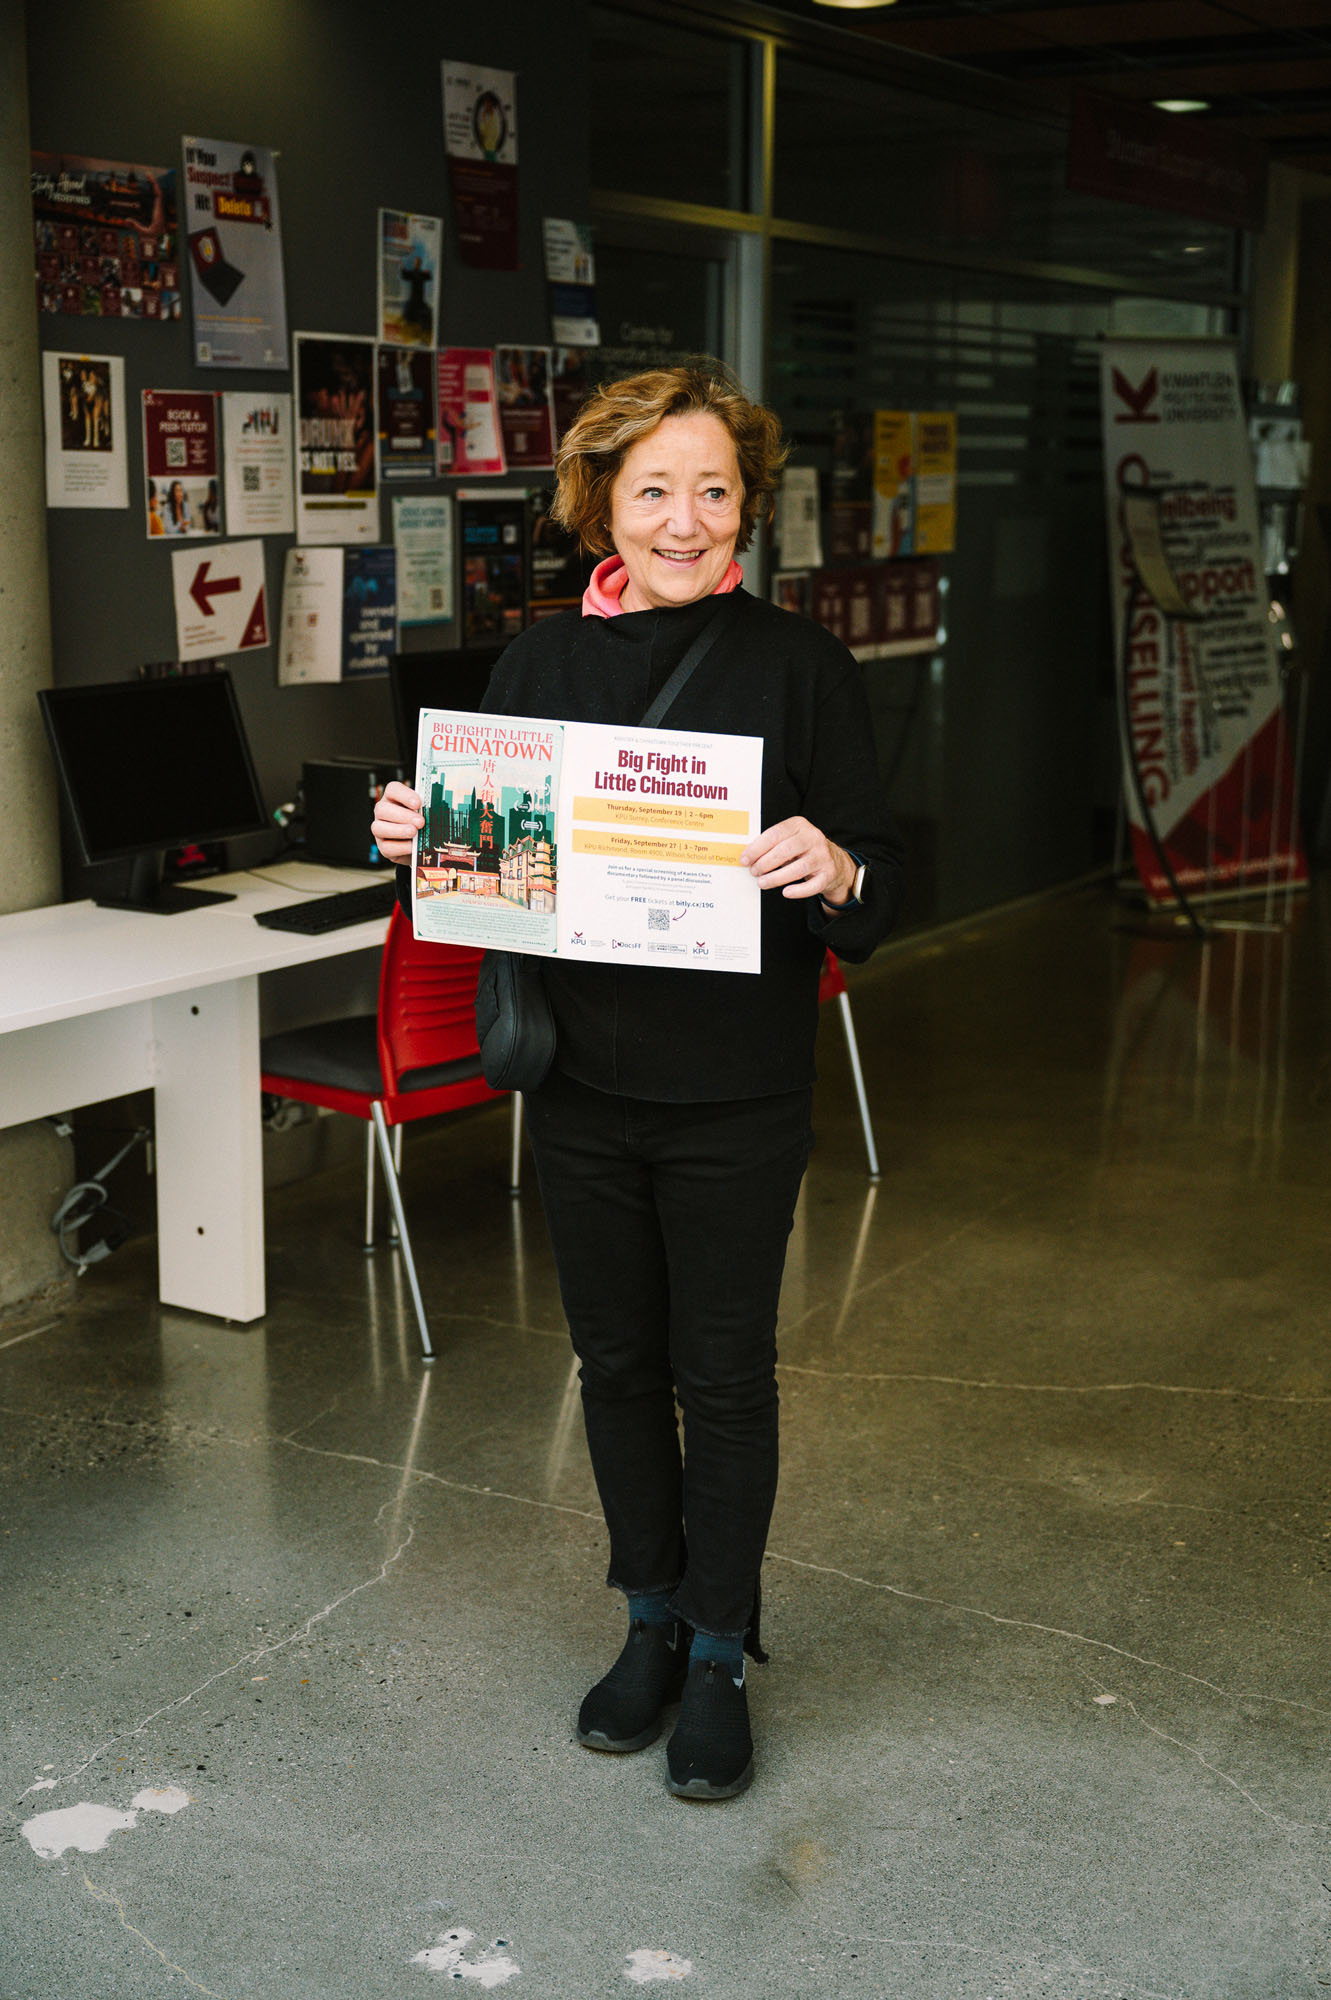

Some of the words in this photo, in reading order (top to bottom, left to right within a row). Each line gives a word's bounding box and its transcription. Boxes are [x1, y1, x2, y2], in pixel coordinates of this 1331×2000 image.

[187, 165, 231, 188] Suspect
[433, 722, 453, 734] BIG
[456, 724, 492, 737] FIGHT
[494, 728, 507, 739] IN
[510, 729, 554, 744] LITTLE
[431, 734, 553, 762] CHINATOWN
[618, 749, 644, 773] Big
[647, 752, 688, 776] Fight
[691, 755, 706, 775] in
[594, 770, 637, 793] Little
[639, 775, 729, 801] Chinatown
[607, 803, 638, 814] Thursday,
[639, 806, 673, 816] September
[699, 812, 714, 820] 6pm
[610, 837, 633, 847] Friday,
[633, 839, 668, 850] September
[694, 845, 709, 853] 7pm
[686, 852, 707, 861] School
[715, 855, 737, 863] Design
[607, 871, 638, 880] documentary
[630, 896, 647, 904] FREE
[648, 897, 668, 905] tickets
[570, 937, 587, 946] KPU
[692, 947, 709, 955] KPU
